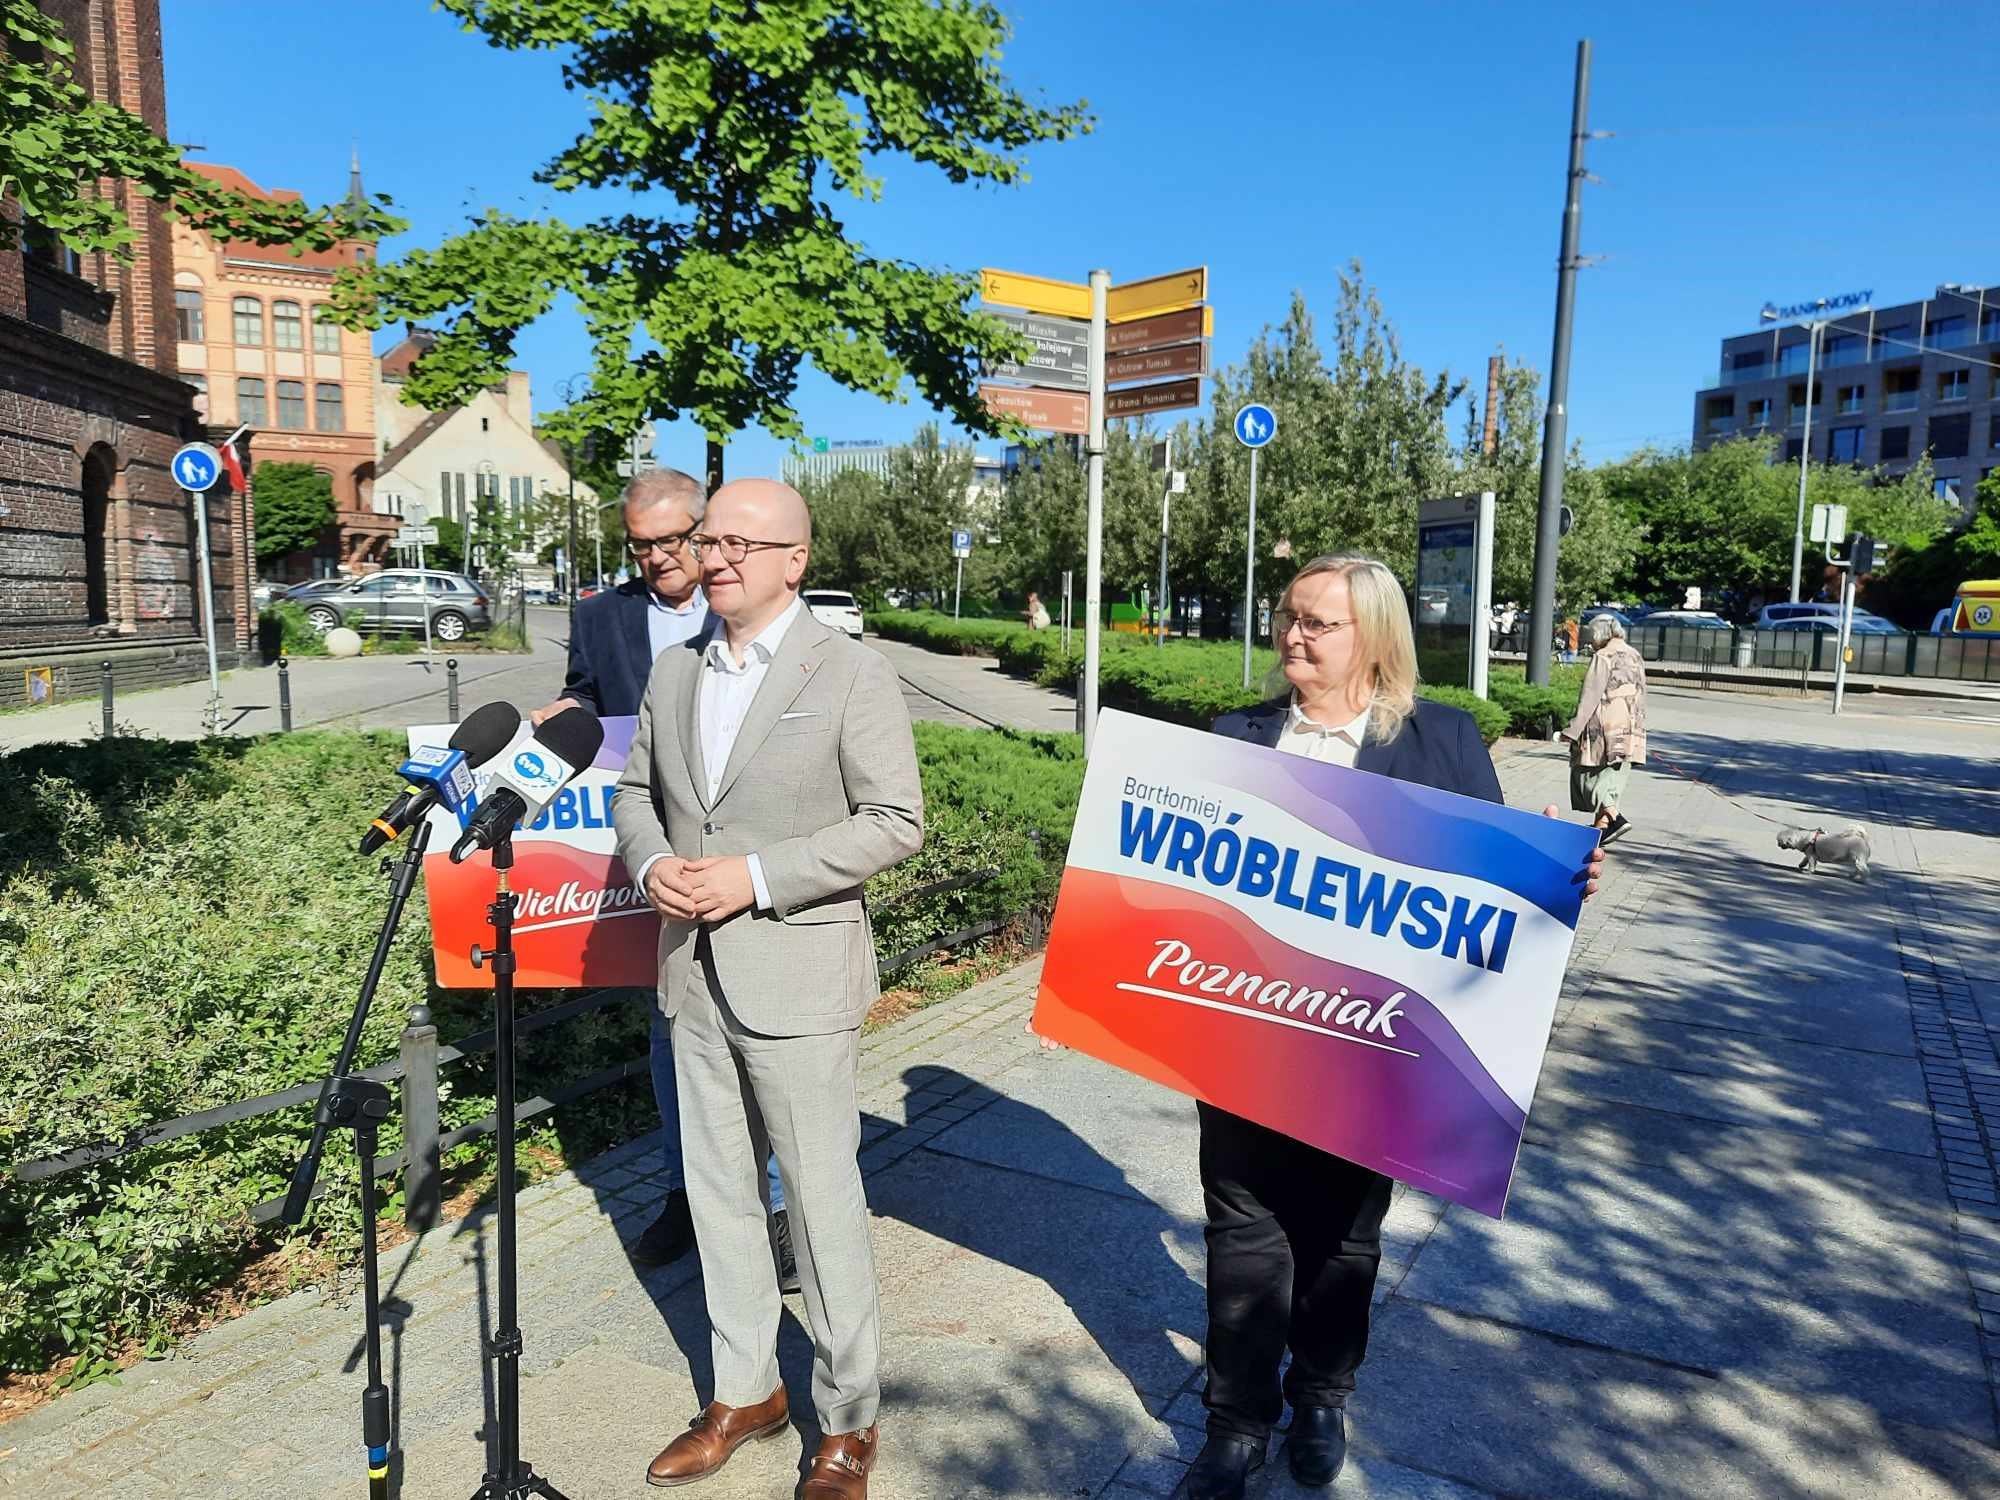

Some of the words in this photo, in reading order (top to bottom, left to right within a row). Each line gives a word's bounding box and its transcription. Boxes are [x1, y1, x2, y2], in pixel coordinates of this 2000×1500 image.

[1122, 776, 1223, 822] Bartłomiej
[1119, 800, 1518, 974] WRÓBLEWSKI
[1146, 939, 1405, 1039] Poznaniak
